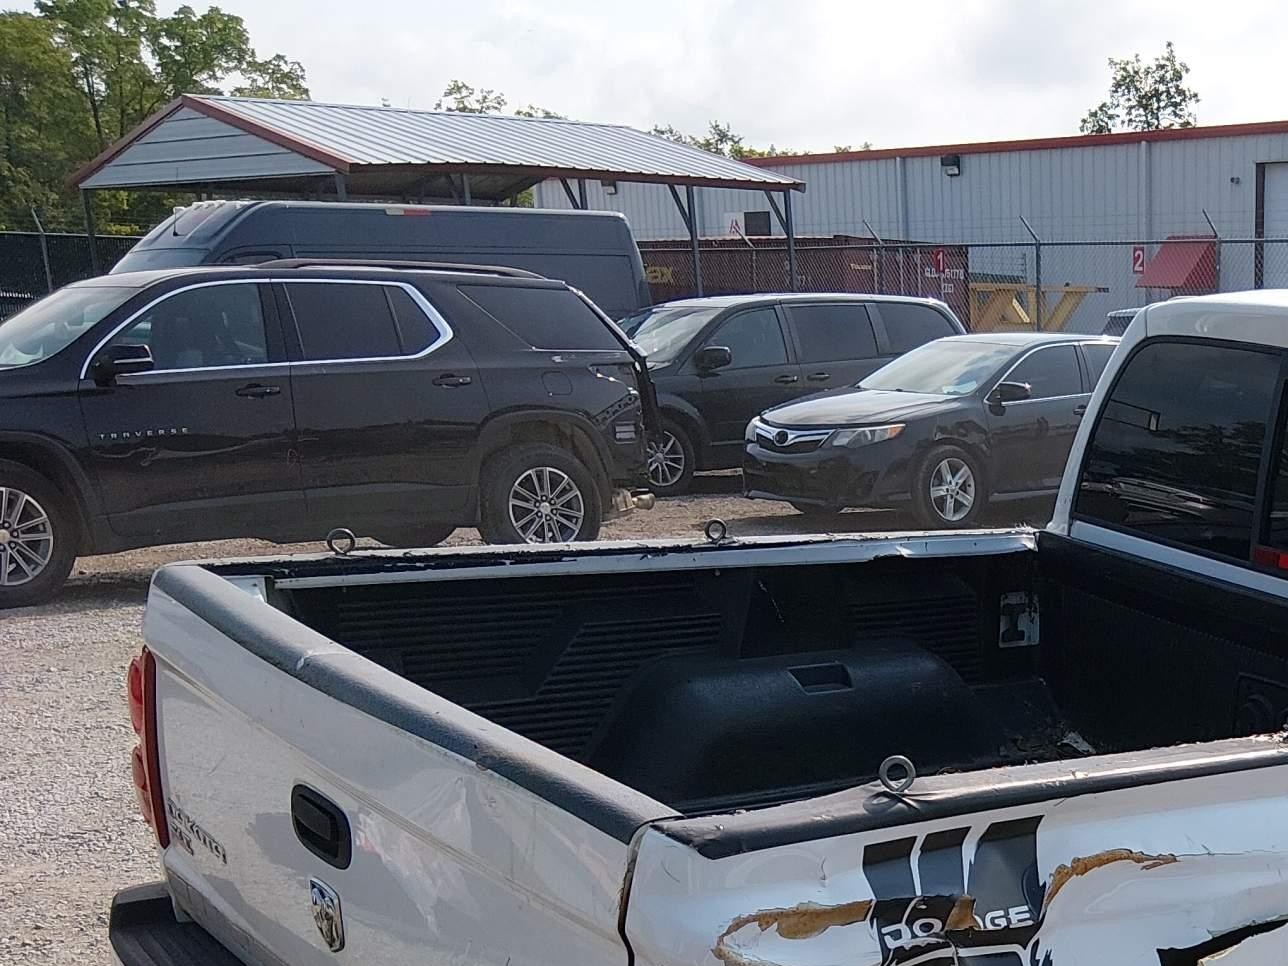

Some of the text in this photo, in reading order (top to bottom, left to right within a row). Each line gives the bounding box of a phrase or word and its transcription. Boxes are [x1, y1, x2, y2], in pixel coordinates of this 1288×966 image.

[937, 251, 944, 271] 1
[1134, 250, 1144, 271] 2
[99, 427, 189, 440] TRAVERSE
